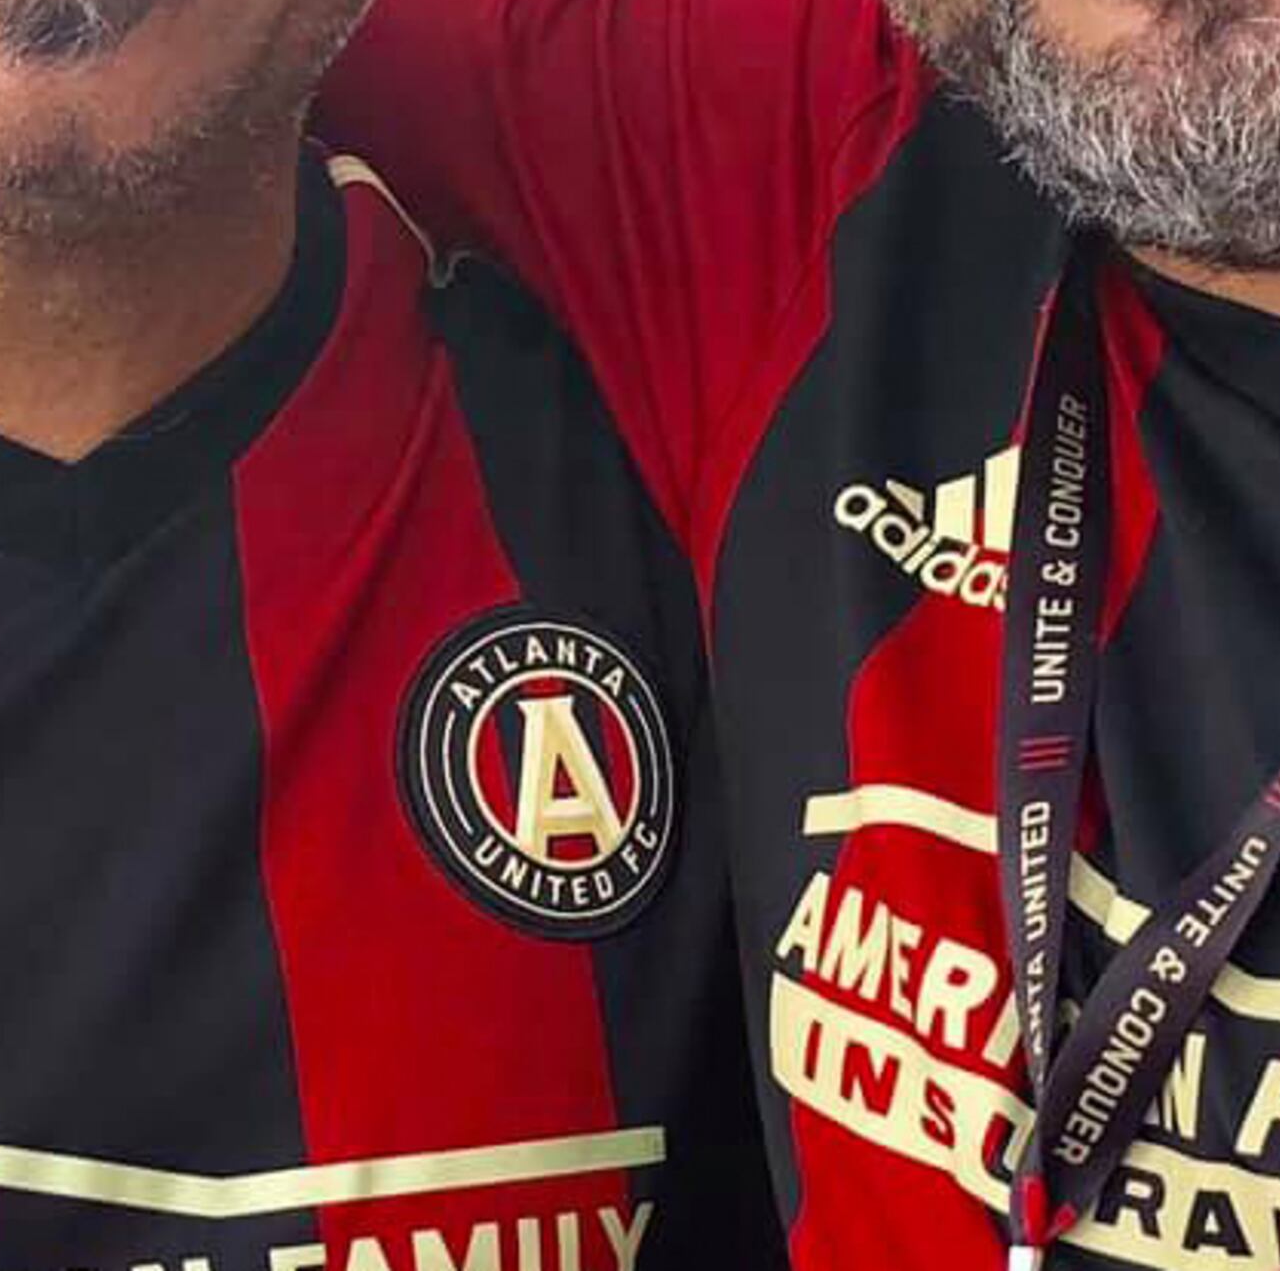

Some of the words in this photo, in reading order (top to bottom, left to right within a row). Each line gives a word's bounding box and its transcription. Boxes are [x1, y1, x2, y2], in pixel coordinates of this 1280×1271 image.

[1045, 393, 1088, 549] CONQUER
[1041, 560, 1077, 587] &
[450, 635, 626, 709] ATLANTA
[1031, 596, 1072, 704] UNITE
[515, 695, 625, 863] A
[474, 836, 613, 906] UNITED
[621, 823, 658, 874] FC
[1021, 800, 1050, 941] UNITED
[1175, 836, 1268, 949] UNITE
[1148, 945, 1187, 984] &
[1055, 987, 1167, 1166] CONQUER
[269, 1201, 655, 1271] MIY
